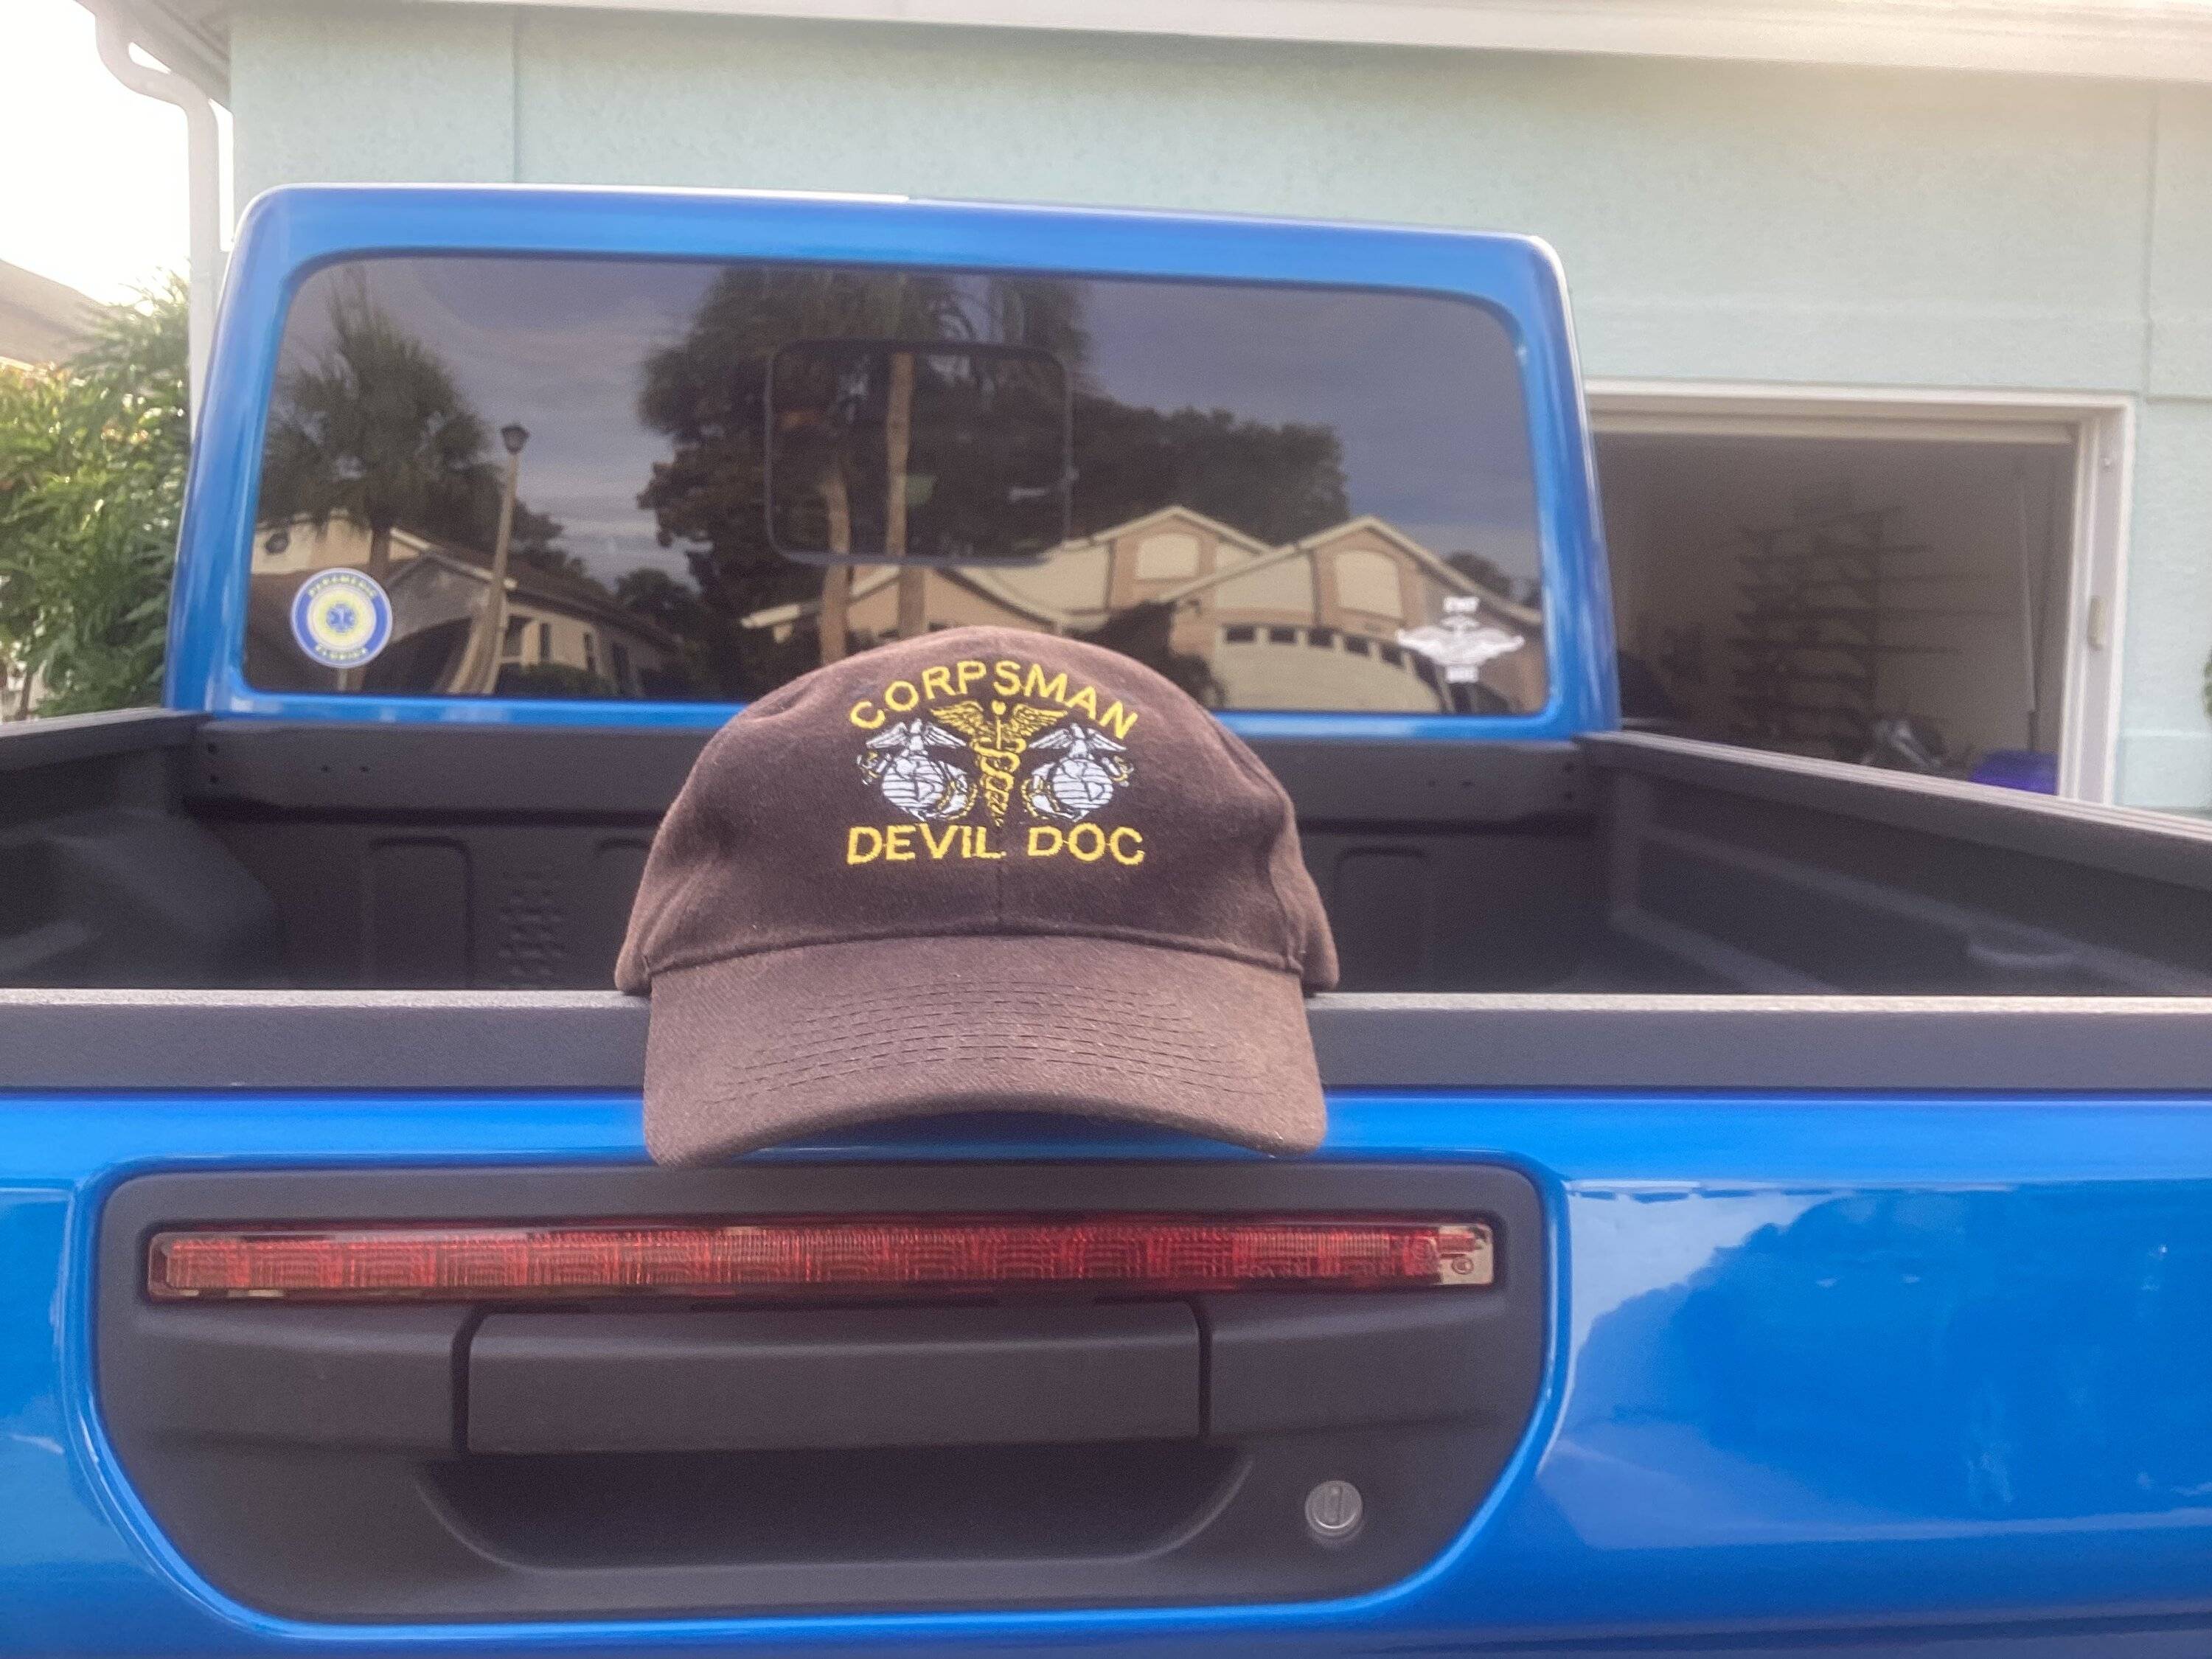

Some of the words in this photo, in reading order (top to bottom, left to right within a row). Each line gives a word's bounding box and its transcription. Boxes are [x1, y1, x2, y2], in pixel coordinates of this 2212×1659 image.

[849, 660, 1138, 739] CORPSMAN
[846, 823, 1006, 865] DEVIL
[1027, 822, 1145, 866] DOC
